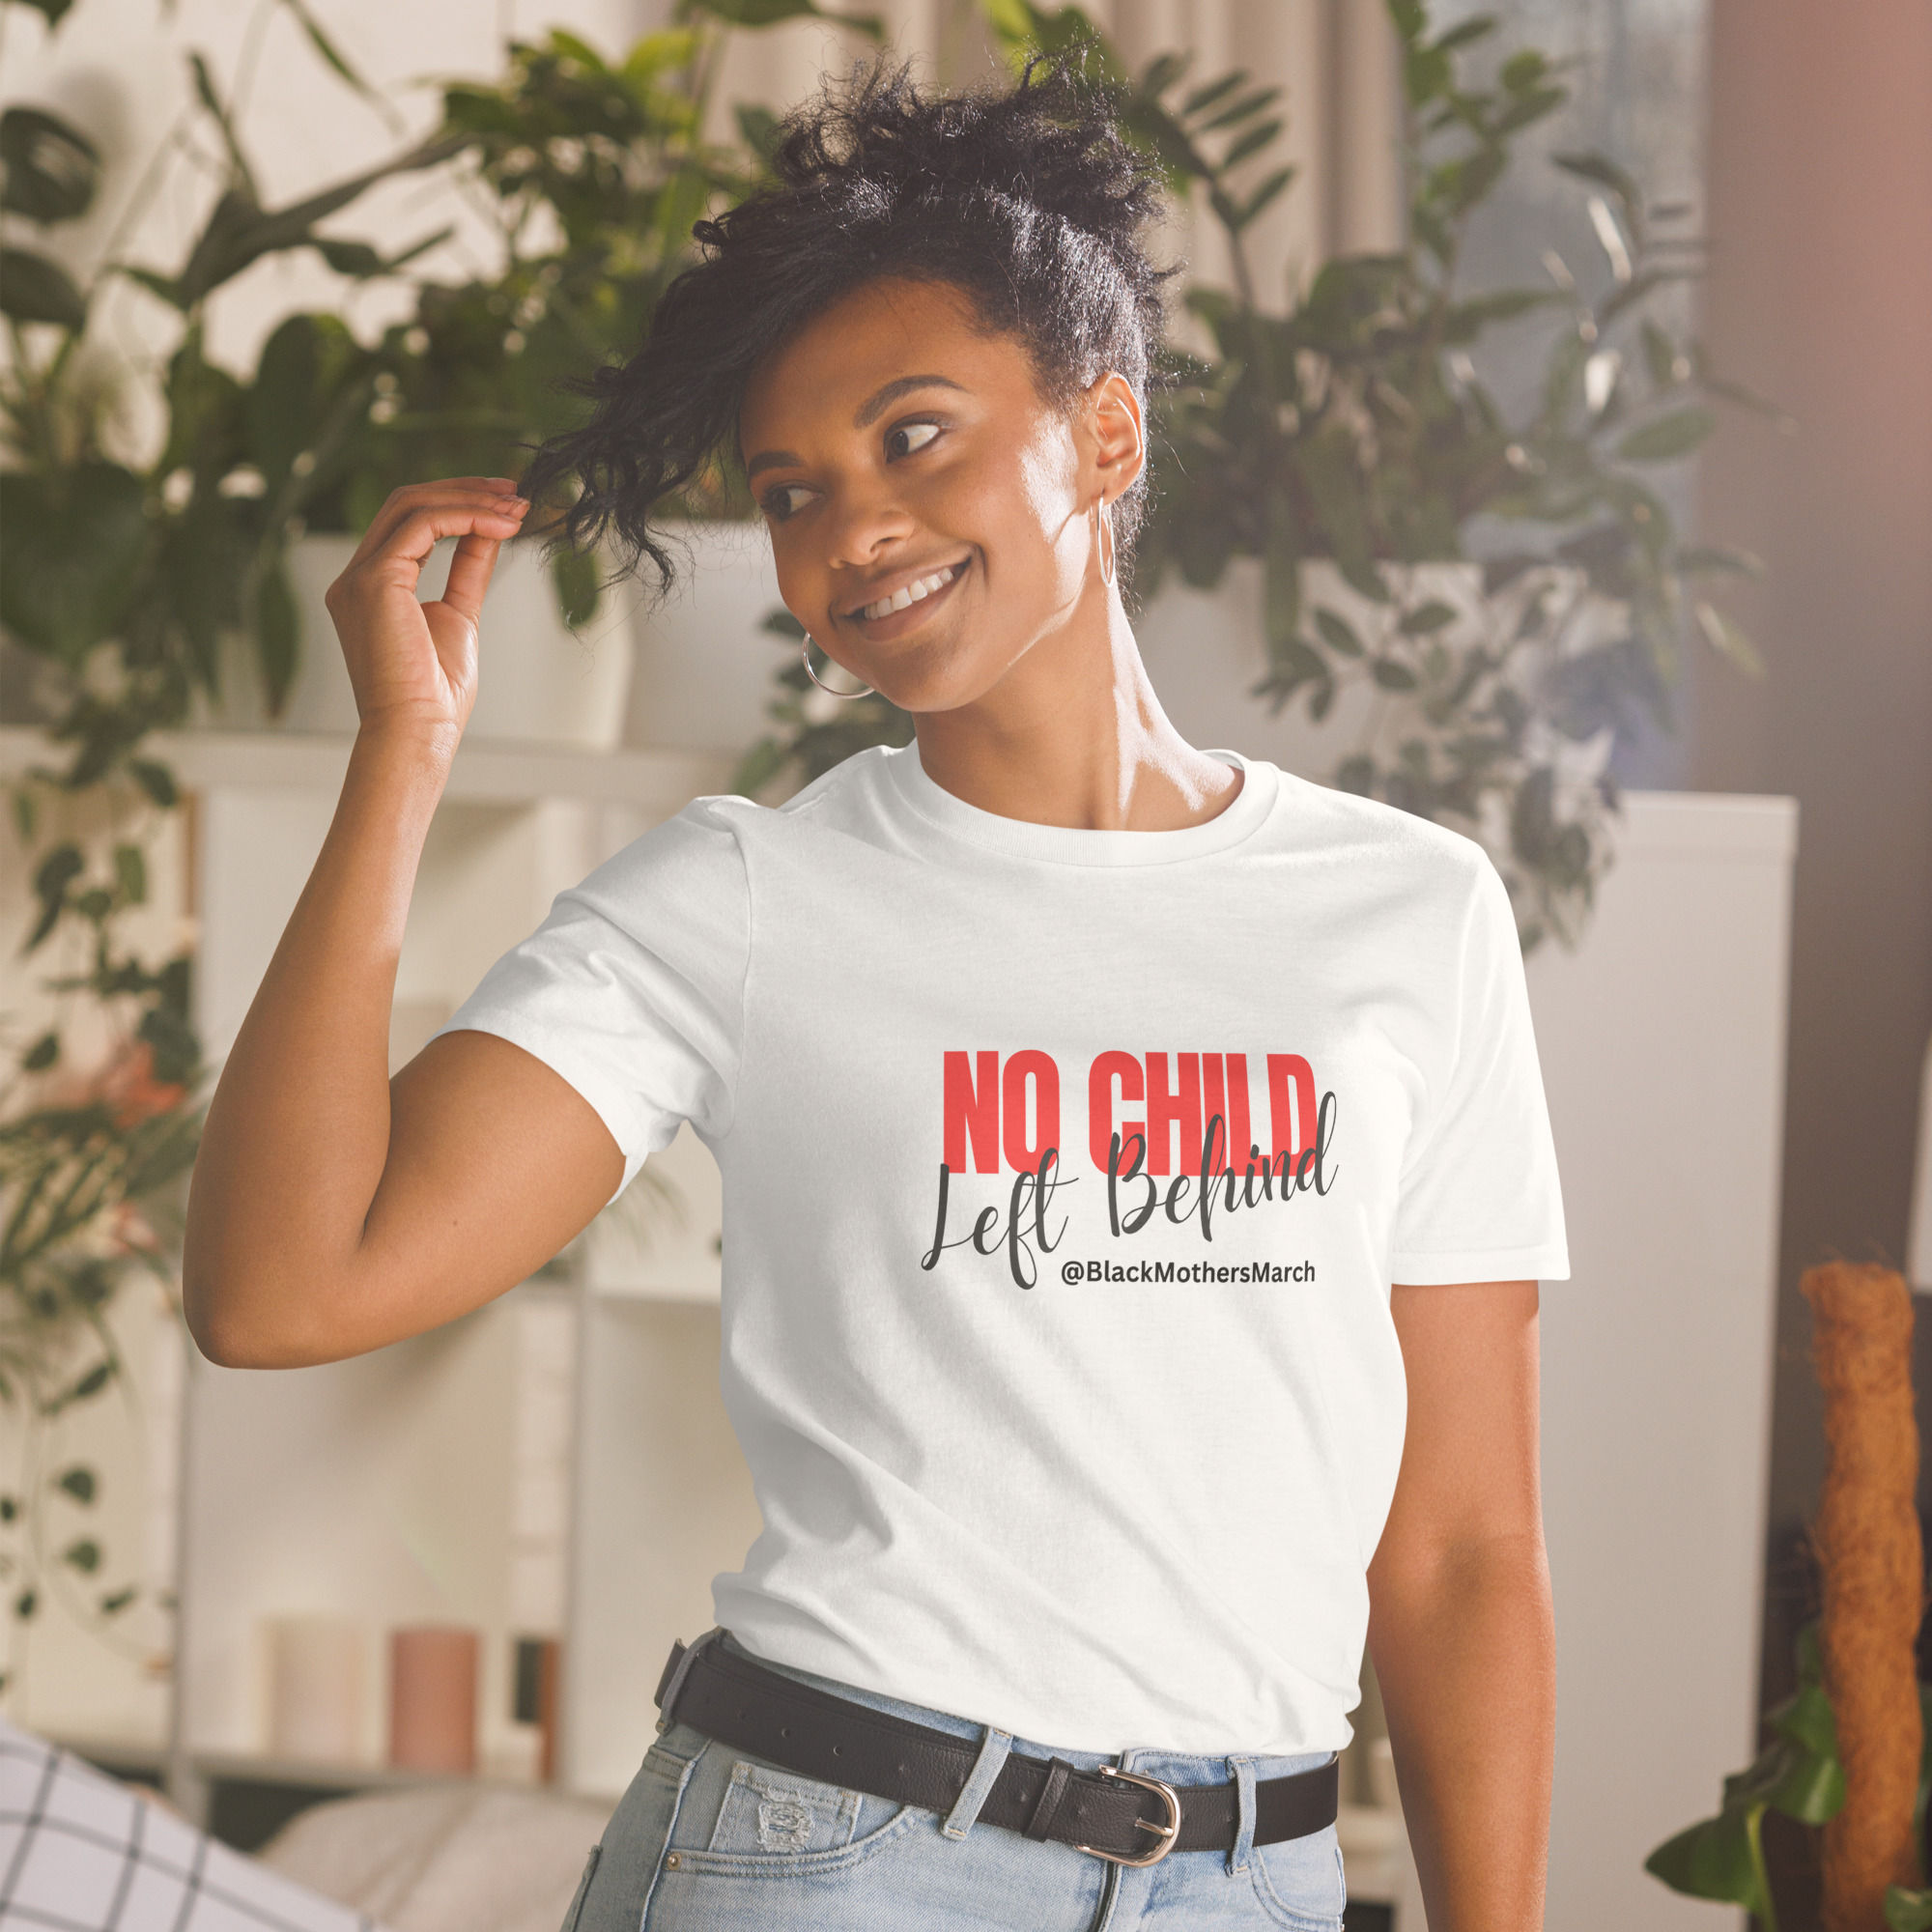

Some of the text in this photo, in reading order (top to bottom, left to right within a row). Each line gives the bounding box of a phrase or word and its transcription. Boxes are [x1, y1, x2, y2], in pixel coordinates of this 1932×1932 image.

[943, 1049, 1318, 1177] NO CHILD
[921, 1091, 1339, 1290] Left Behind
[1061, 1260, 1316, 1286] @BlackMothersMarch
